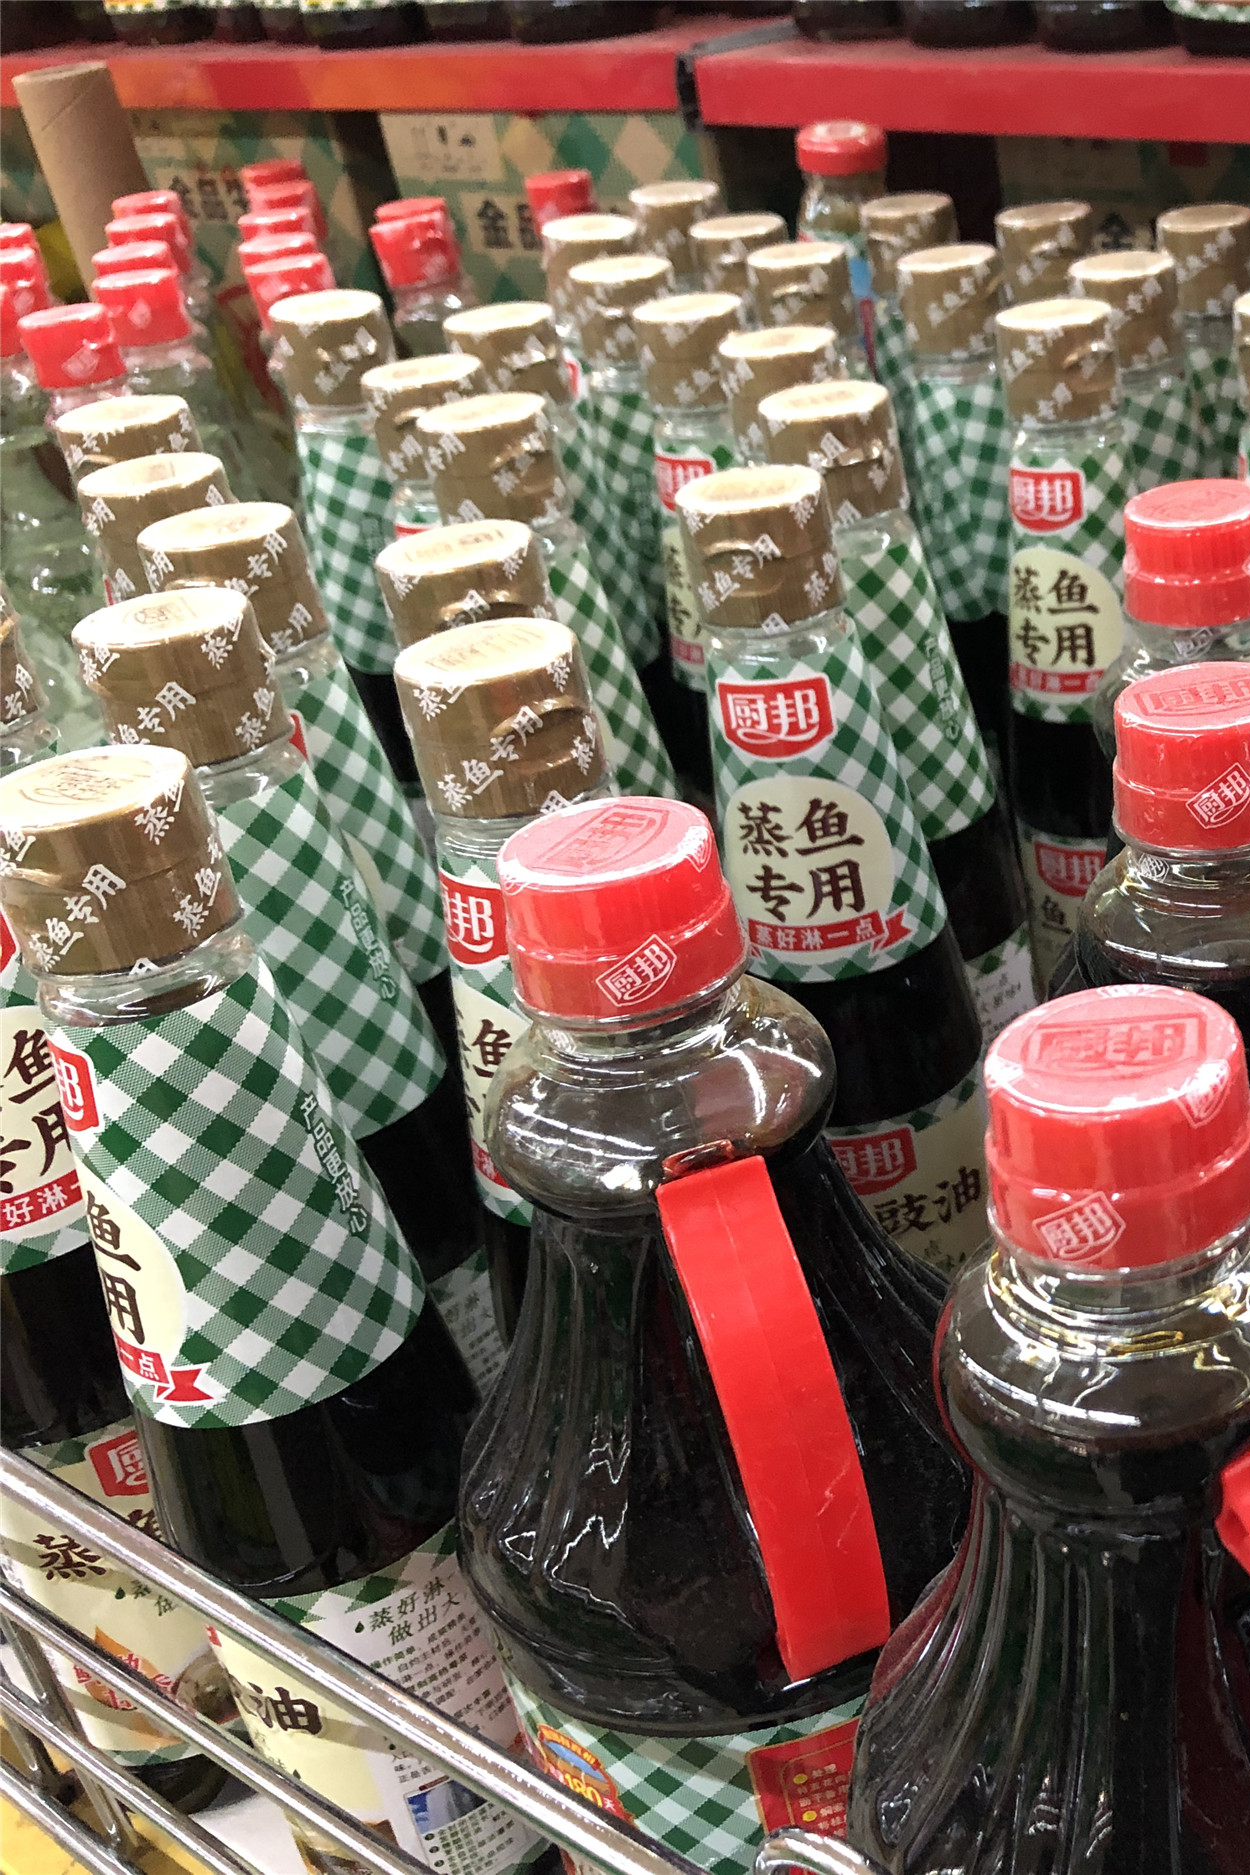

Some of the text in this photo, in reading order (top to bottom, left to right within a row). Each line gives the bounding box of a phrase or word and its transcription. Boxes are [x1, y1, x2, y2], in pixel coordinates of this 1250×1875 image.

[698, 533, 781, 613] 蒸鱼专用
[1014, 567, 1100, 615] 蒸鱼
[1015, 617, 1097, 668] 专用
[726, 689, 820, 744] 厨邦
[437, 705, 544, 812] 蒸鱼专用
[1193, 770, 1250, 824] 厨邦
[737, 798, 866, 858] 蒸鱼
[28, 863, 127, 973] 蒸鱼专用
[746, 859, 867, 923] 专用
[755, 918, 877, 950] 蒸好淋一点
[604, 943, 670, 1001] 厨邦
[301, 1091, 369, 1234] 产品更放心
[1042, 1201, 1115, 1256] 厨邦
